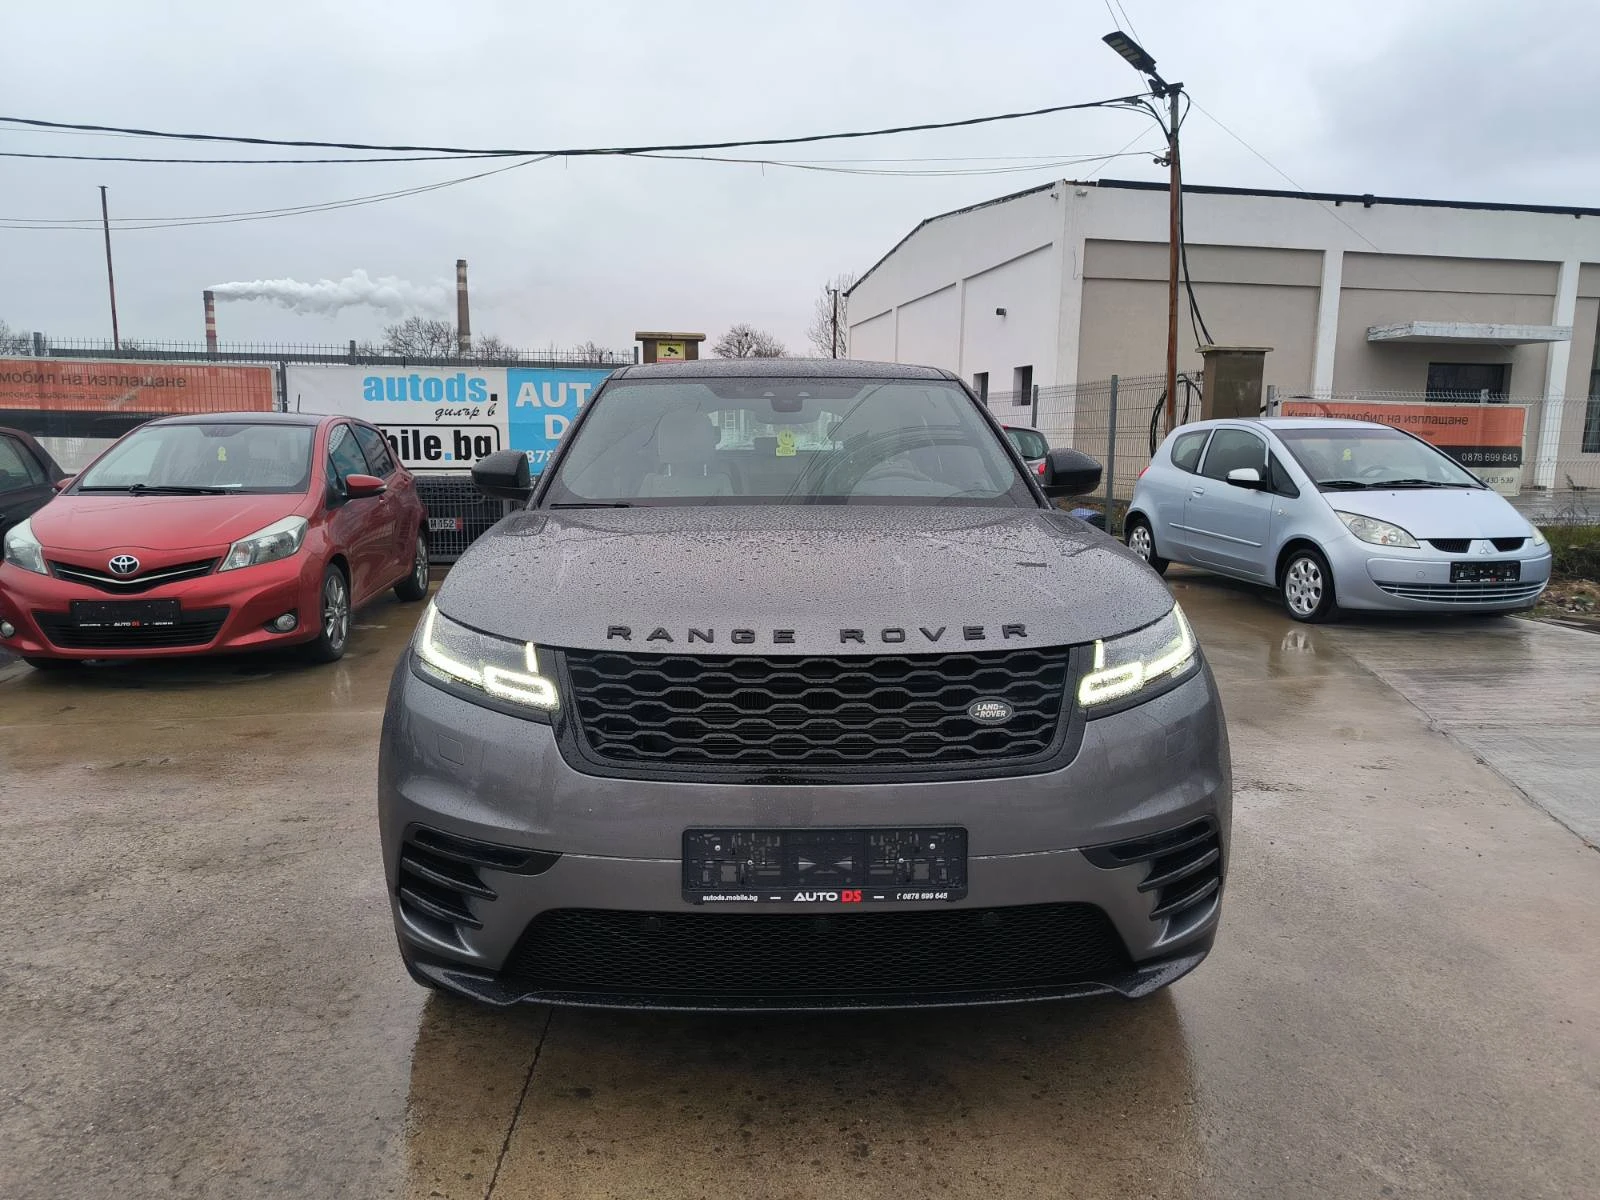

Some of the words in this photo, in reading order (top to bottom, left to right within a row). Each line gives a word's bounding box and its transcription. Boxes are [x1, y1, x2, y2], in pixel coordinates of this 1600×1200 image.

[61, 374, 83, 386] на
[88, 374, 187, 388] изплащане
[1387, 415, 1401, 425] на
[1461, 453, 1482, 462] 0878
[1485, 453, 1500, 462] 699
[1502, 453, 1518, 462] 645
[606, 625, 796, 645] RANGE
[839, 623, 1028, 645] ROVER
[977, 703, 999, 711] LAND
[979, 710, 1006, 718] ROVER
[793, 891, 839, 902] AUTO
[841, 889, 863, 903] DS
[902, 892, 920, 900] 0878
[935, 892, 948, 900] 645
